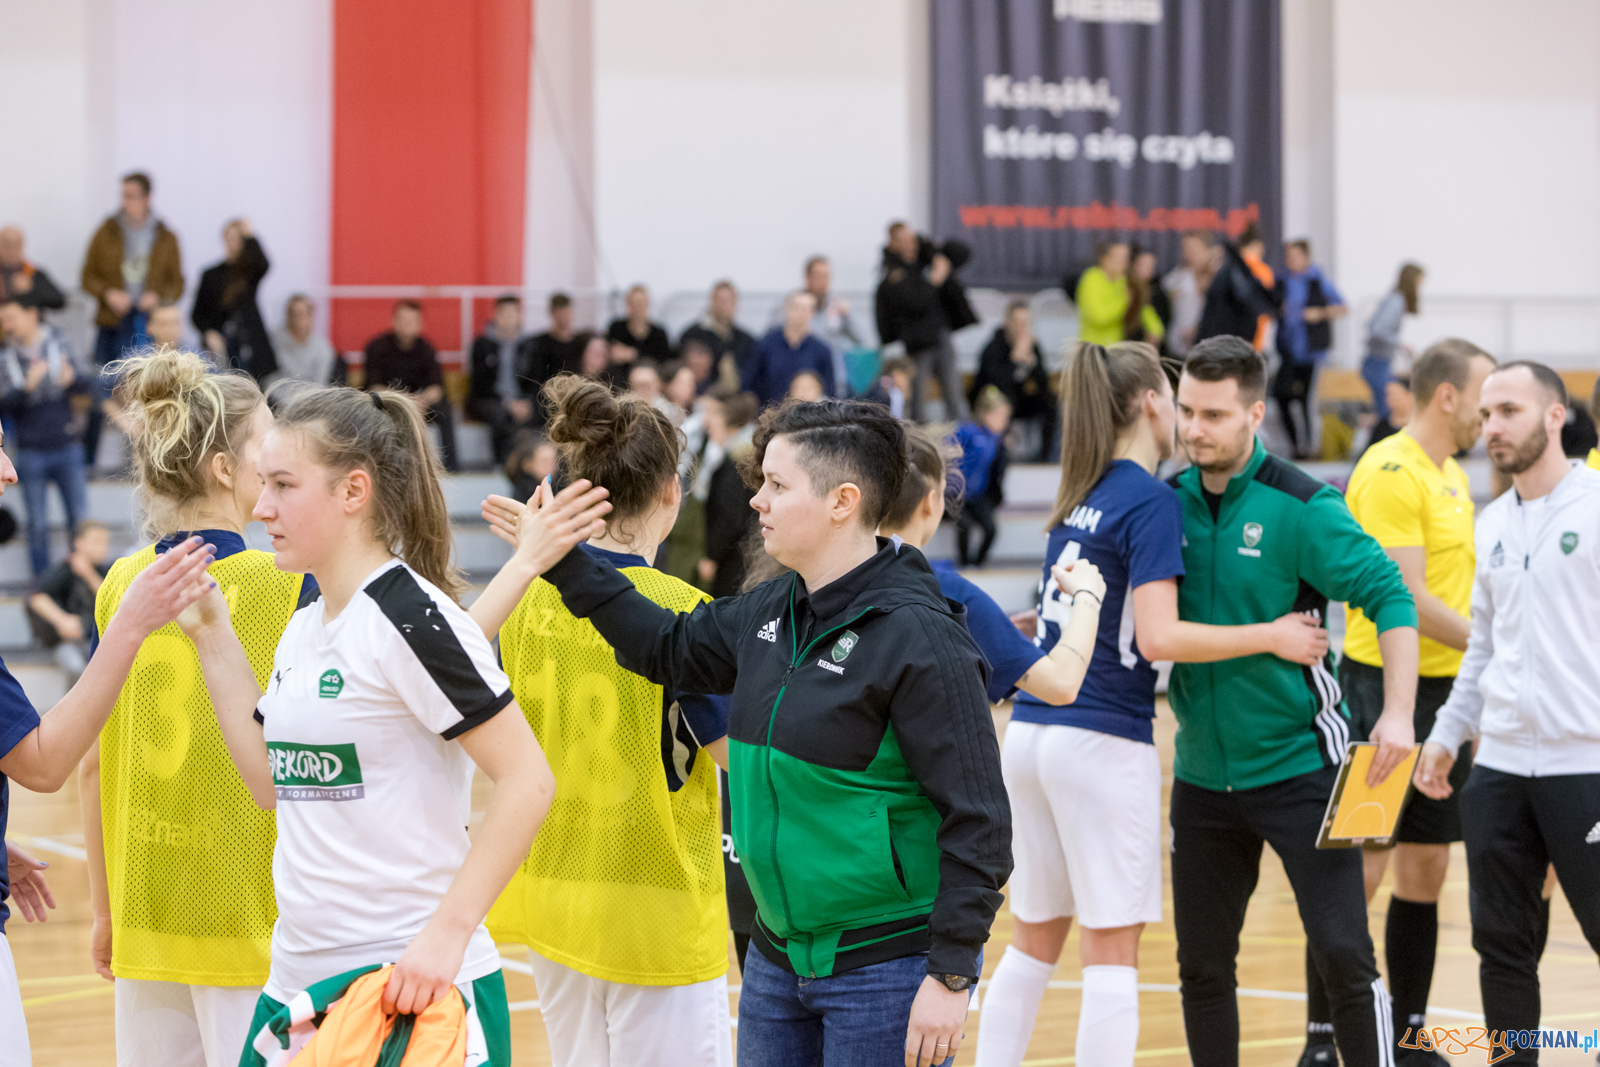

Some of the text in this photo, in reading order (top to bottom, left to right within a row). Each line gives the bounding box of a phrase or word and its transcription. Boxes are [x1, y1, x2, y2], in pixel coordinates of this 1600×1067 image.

[983, 74, 1120, 118] Książki,
[983, 123, 1235, 170] które się czyta
[138, 633, 197, 780] 3
[526, 658, 636, 806] 18
[267, 748, 344, 783] REKORD
